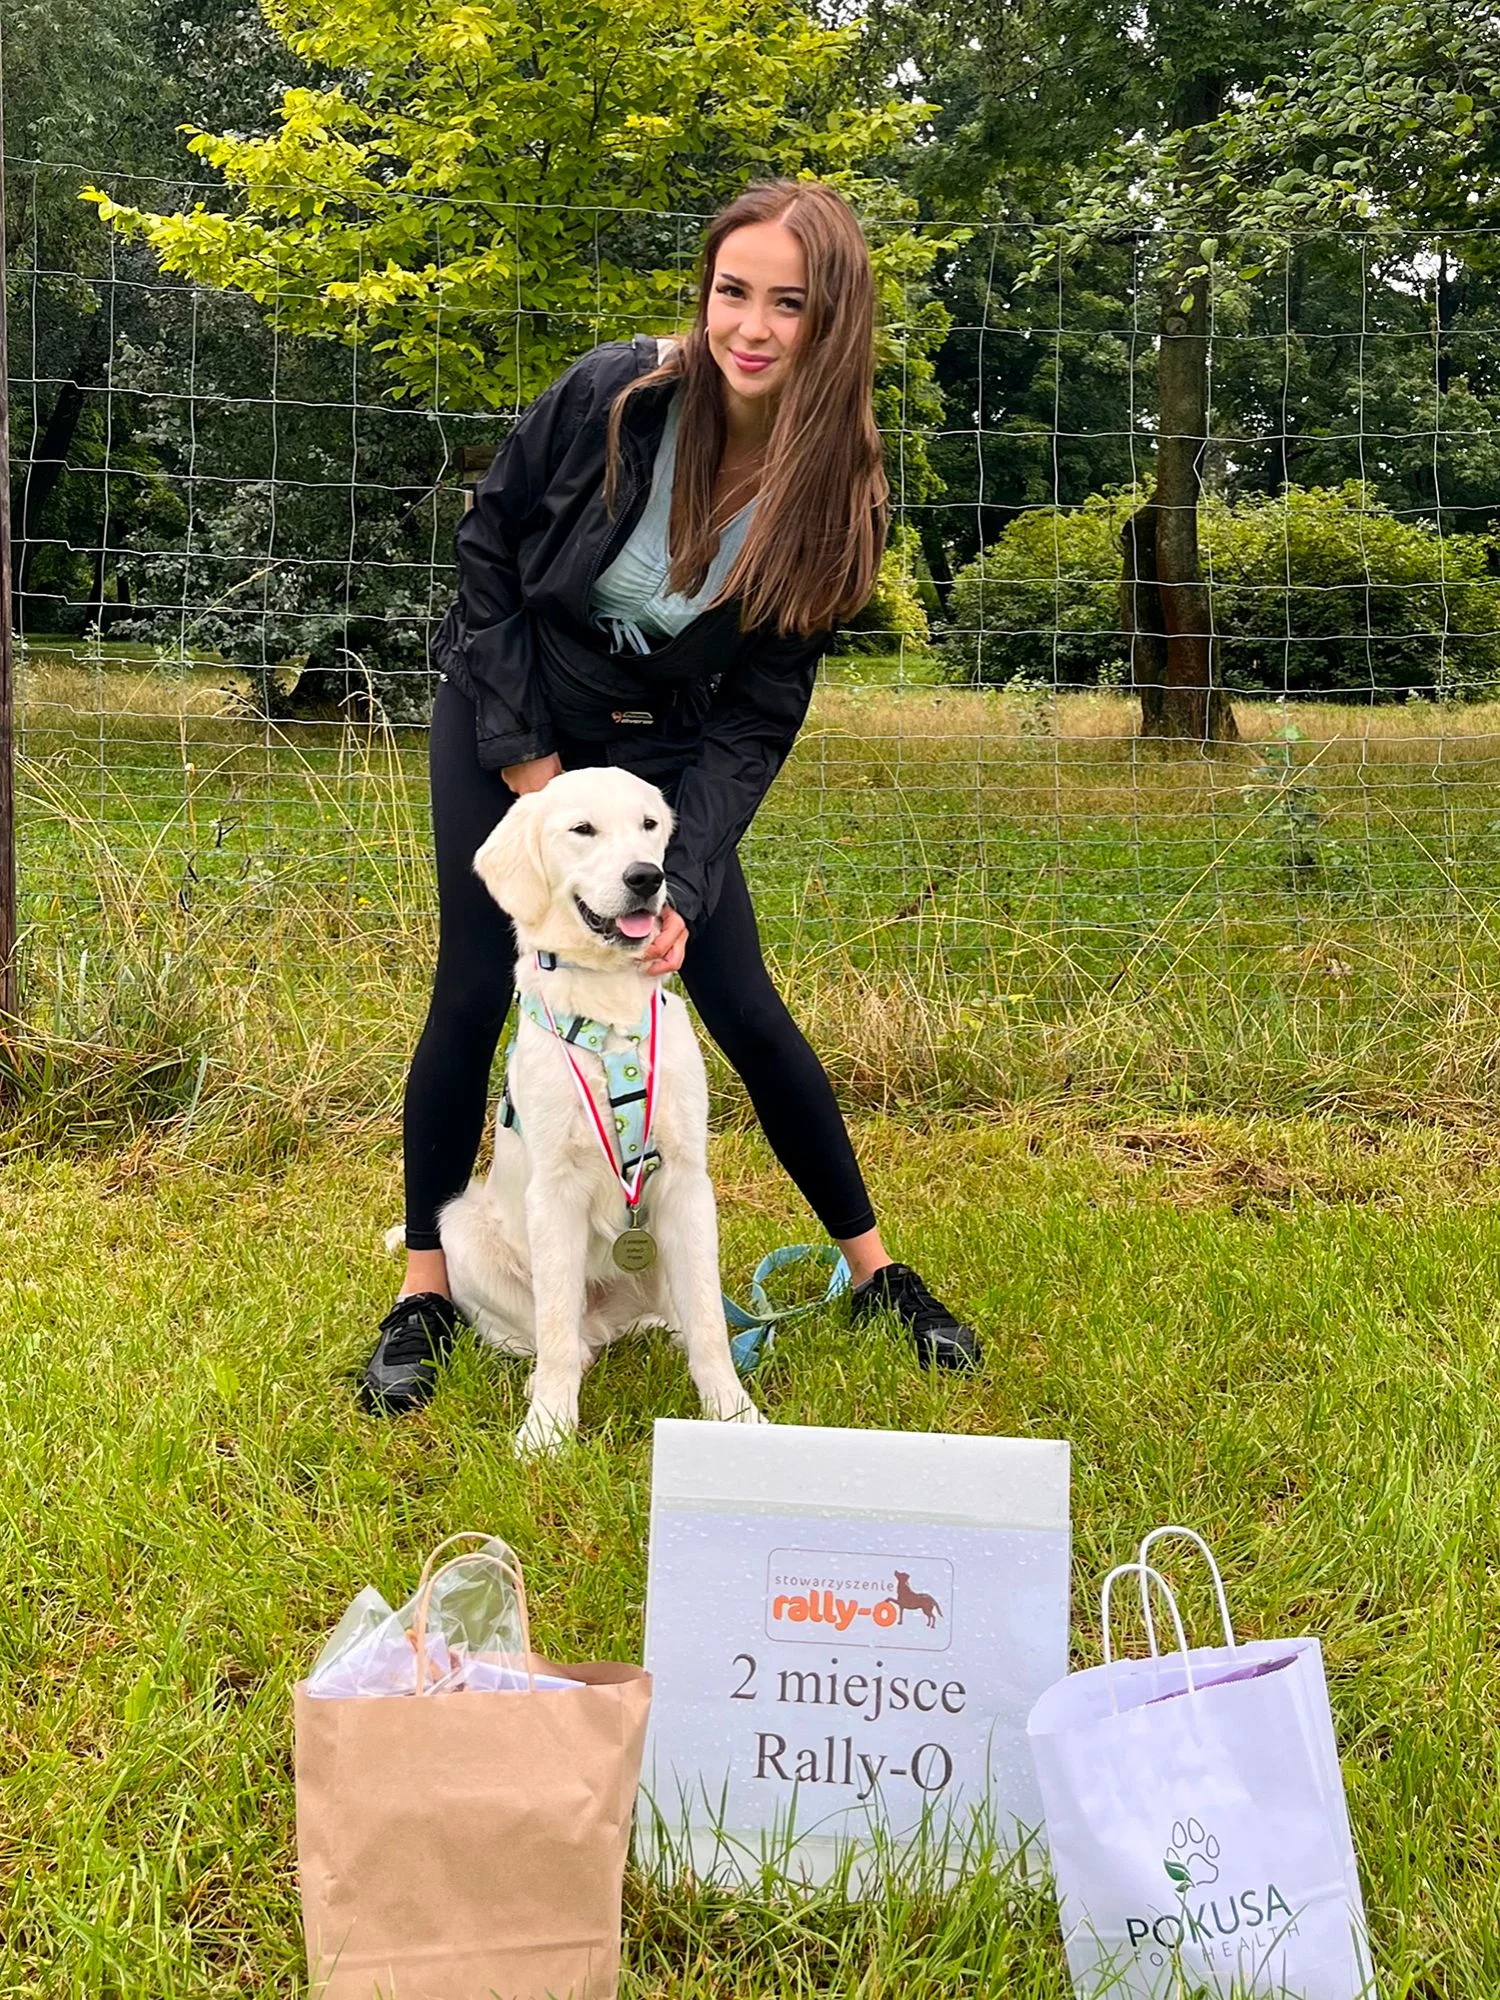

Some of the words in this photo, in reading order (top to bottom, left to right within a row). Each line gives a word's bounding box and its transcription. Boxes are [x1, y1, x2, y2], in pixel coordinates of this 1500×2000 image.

[775, 1575, 895, 1592] stowarzyszenie
[773, 1590, 897, 1631] rally-o
[730, 1654, 758, 1700] 2
[777, 1658, 966, 1721] miejsce
[753, 1732, 953, 1800] Rally-O
[1126, 1884, 1292, 1949] POKUSA
[1134, 1951, 1167, 1967] FO
